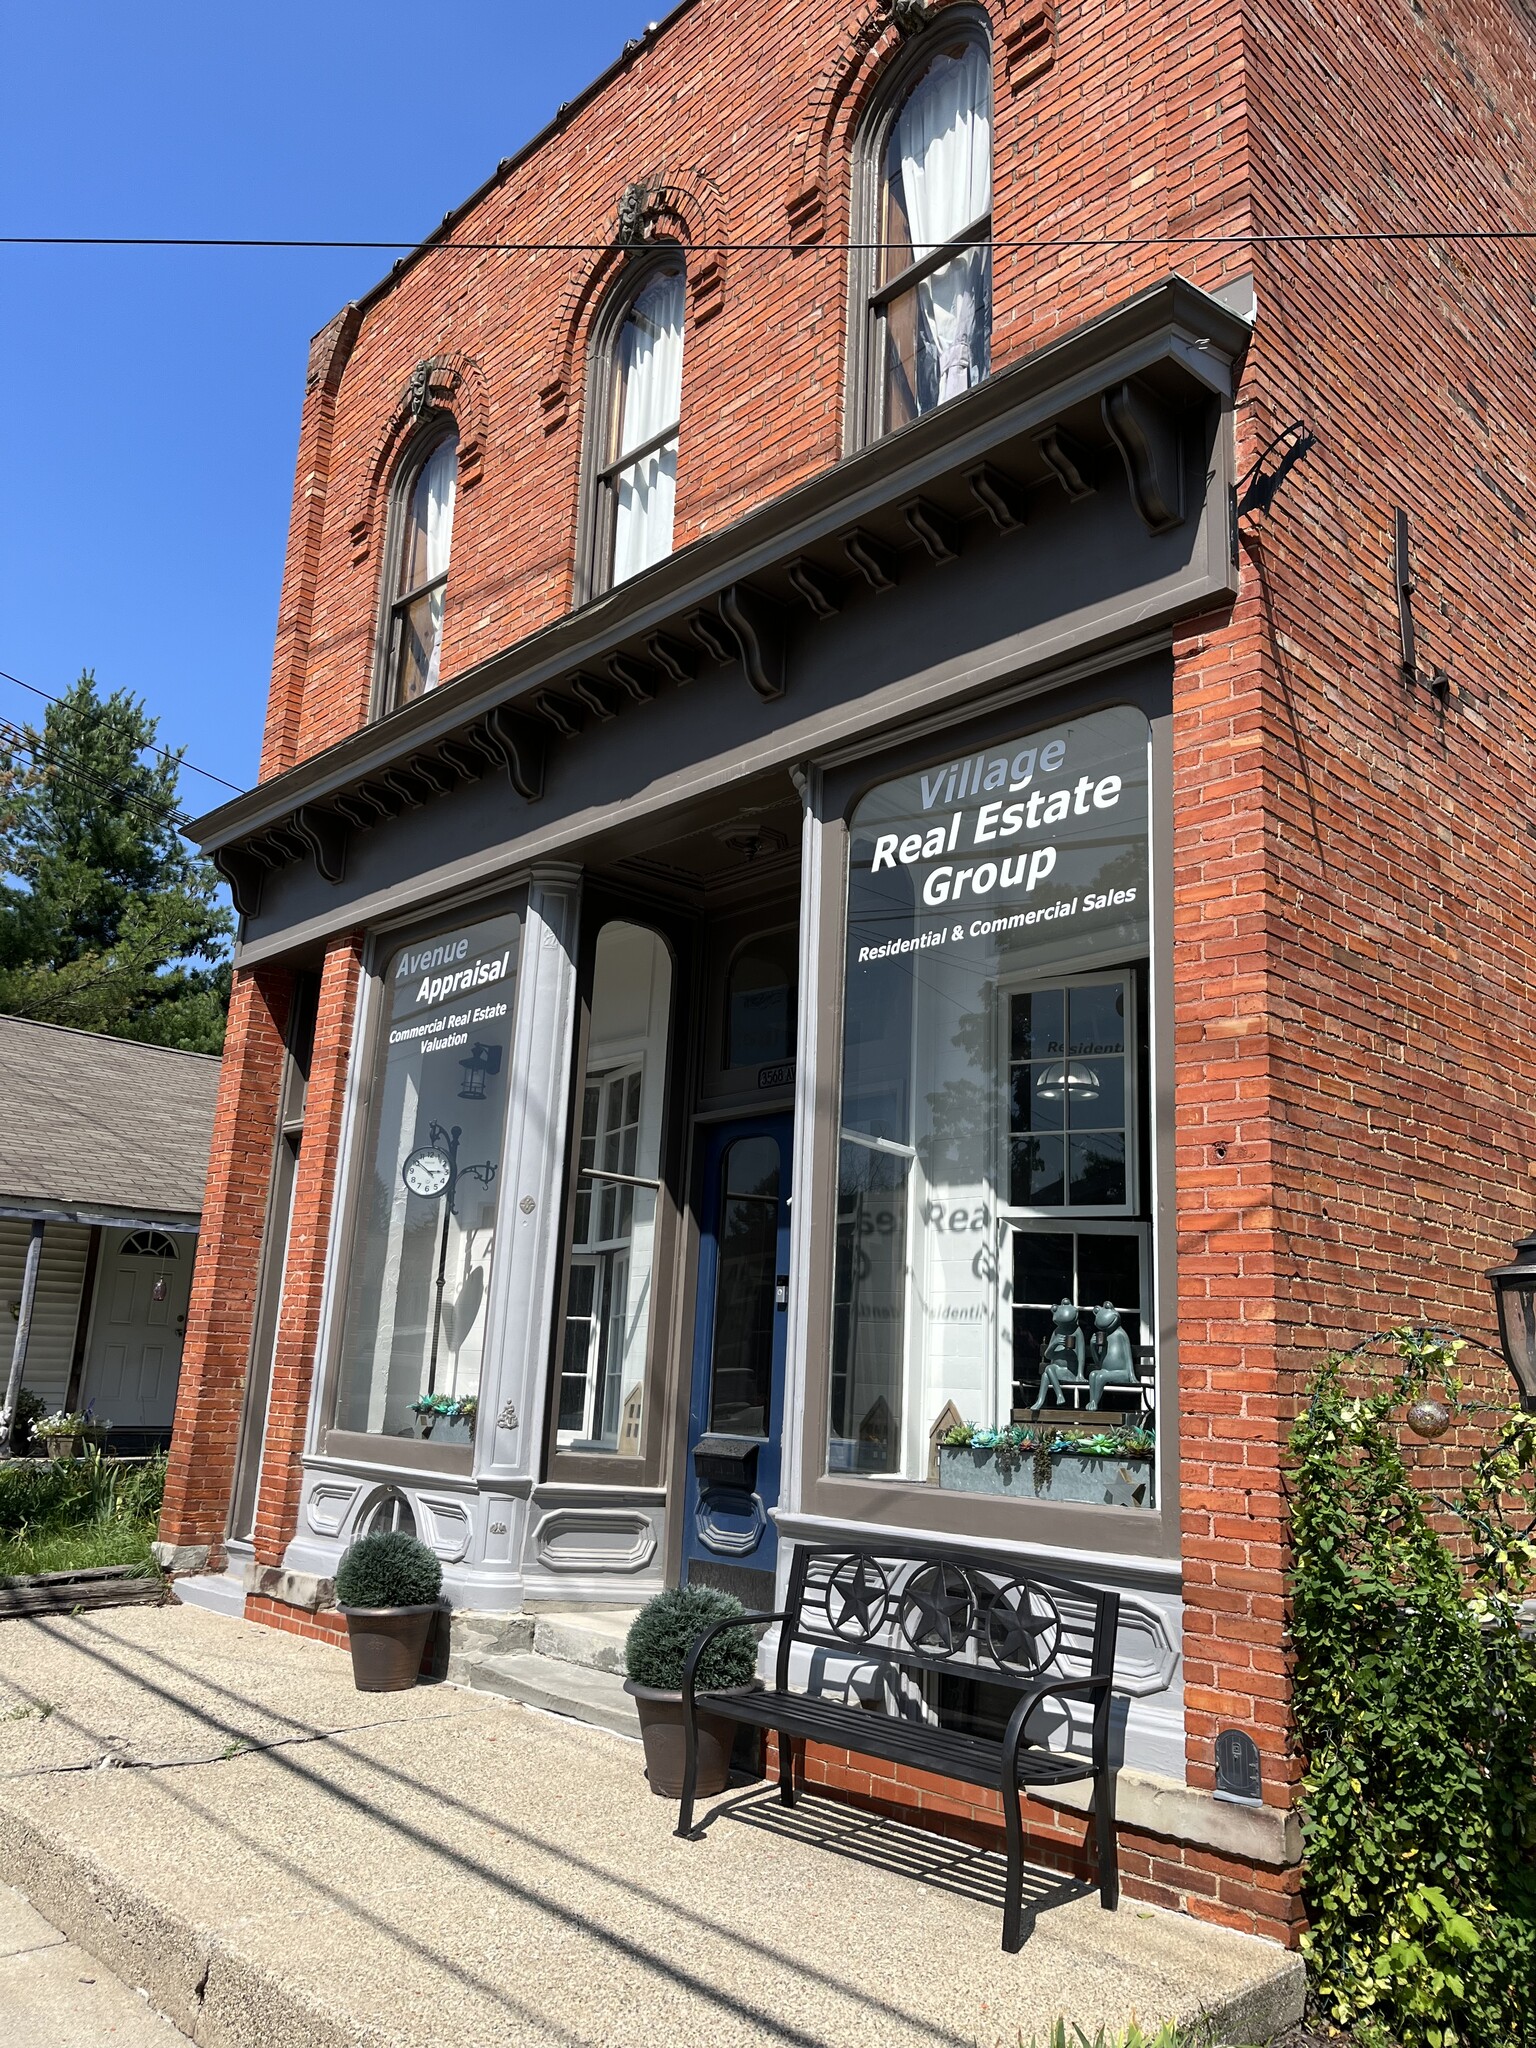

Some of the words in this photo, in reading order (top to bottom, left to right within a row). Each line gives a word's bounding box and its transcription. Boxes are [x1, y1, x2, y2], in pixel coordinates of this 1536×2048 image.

[919, 738, 1067, 810] Village
[870, 811, 962, 873] Real
[973, 774, 1122, 845] Estate
[922, 845, 1057, 906] Group
[857, 927, 947, 963] Residential
[951, 924, 965, 941] &
[969, 897, 1078, 938] Commercial
[1081, 887, 1137, 912] Sales
[395, 938, 469, 979] Avenue
[415, 951, 510, 1004] Appraisal
[389, 1016, 446, 1044] Commercial
[447, 1010, 471, 1029] Real
[472, 1002, 507, 1023] Estate
[420, 1032, 468, 1054] Valuation
[761, 1068, 783, 1085] 3568
